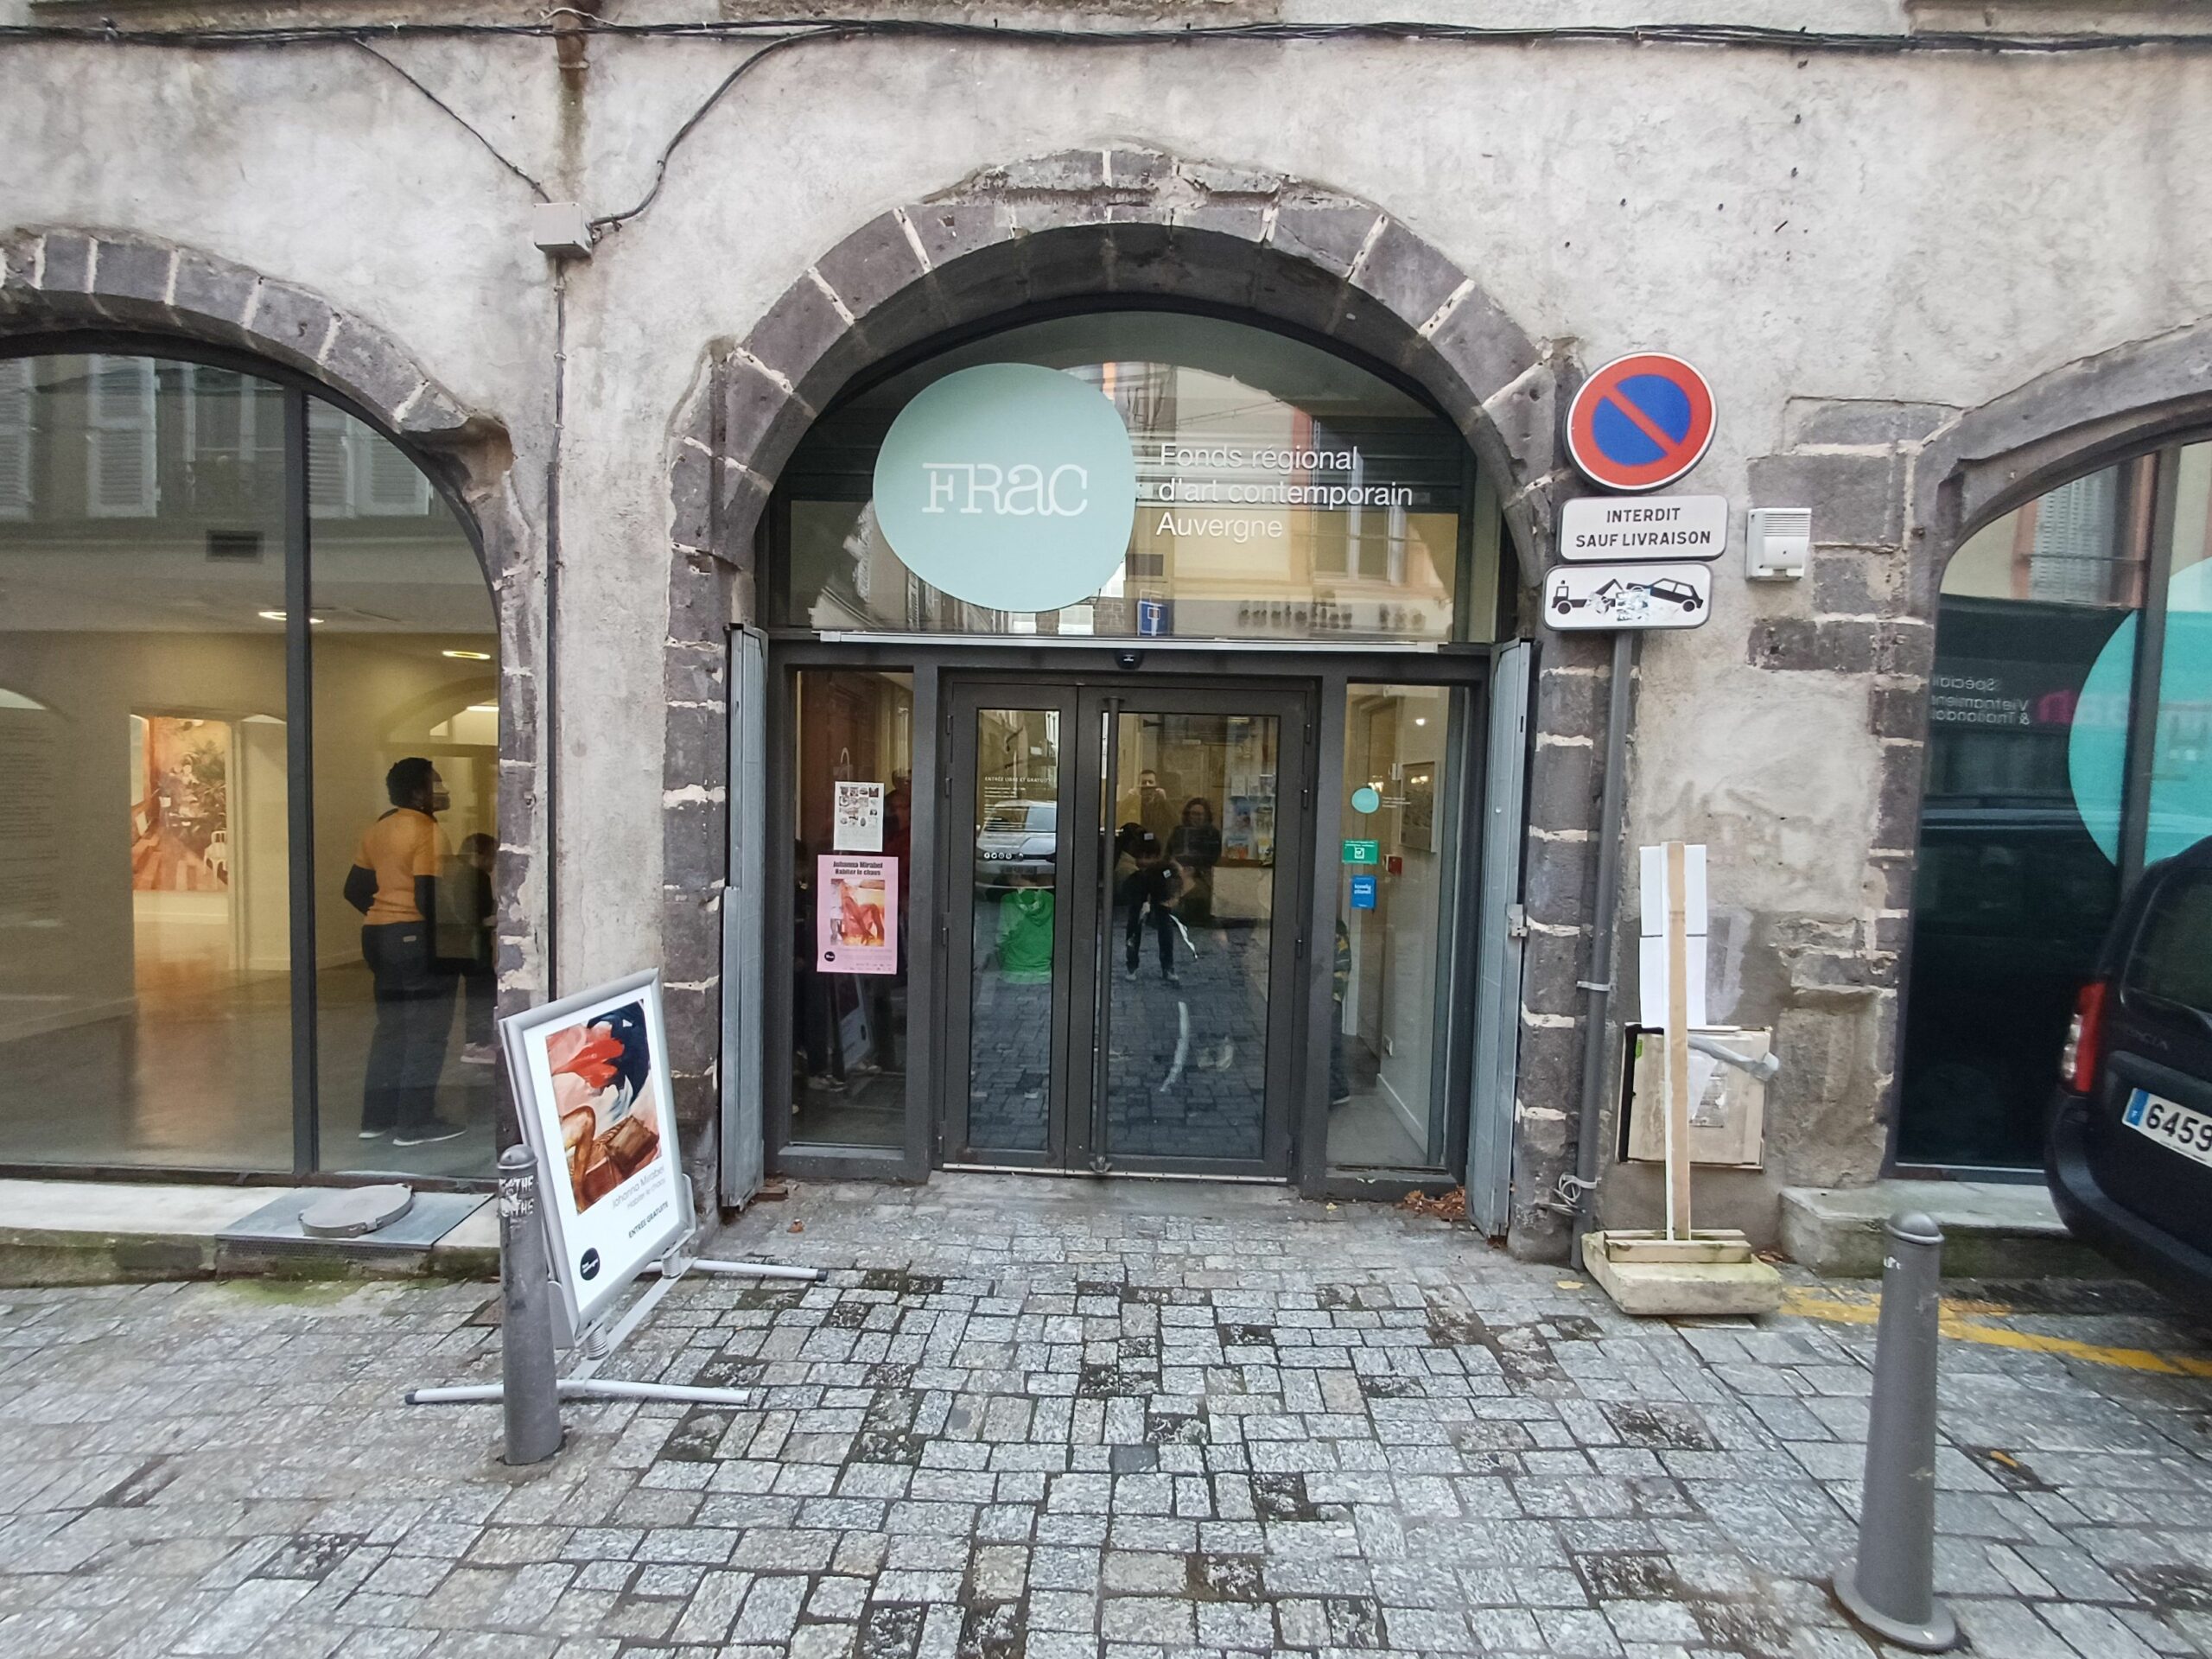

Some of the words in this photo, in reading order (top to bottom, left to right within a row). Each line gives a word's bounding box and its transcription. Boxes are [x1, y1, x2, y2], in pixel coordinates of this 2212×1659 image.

[1160, 443, 1243, 468] Fonds
[1251, 445, 1357, 474] régional
[1158, 477, 1218, 503] d'art
[1227, 480, 1414, 511] contemporain
[1155, 512, 1283, 543] Auvergne
[1606, 507, 1681, 524] INTERDIT
[1575, 533, 1619, 548] SAUF
[1622, 531, 1711, 547] LIVRAISON
[2145, 1103, 2212, 1153] 6459
